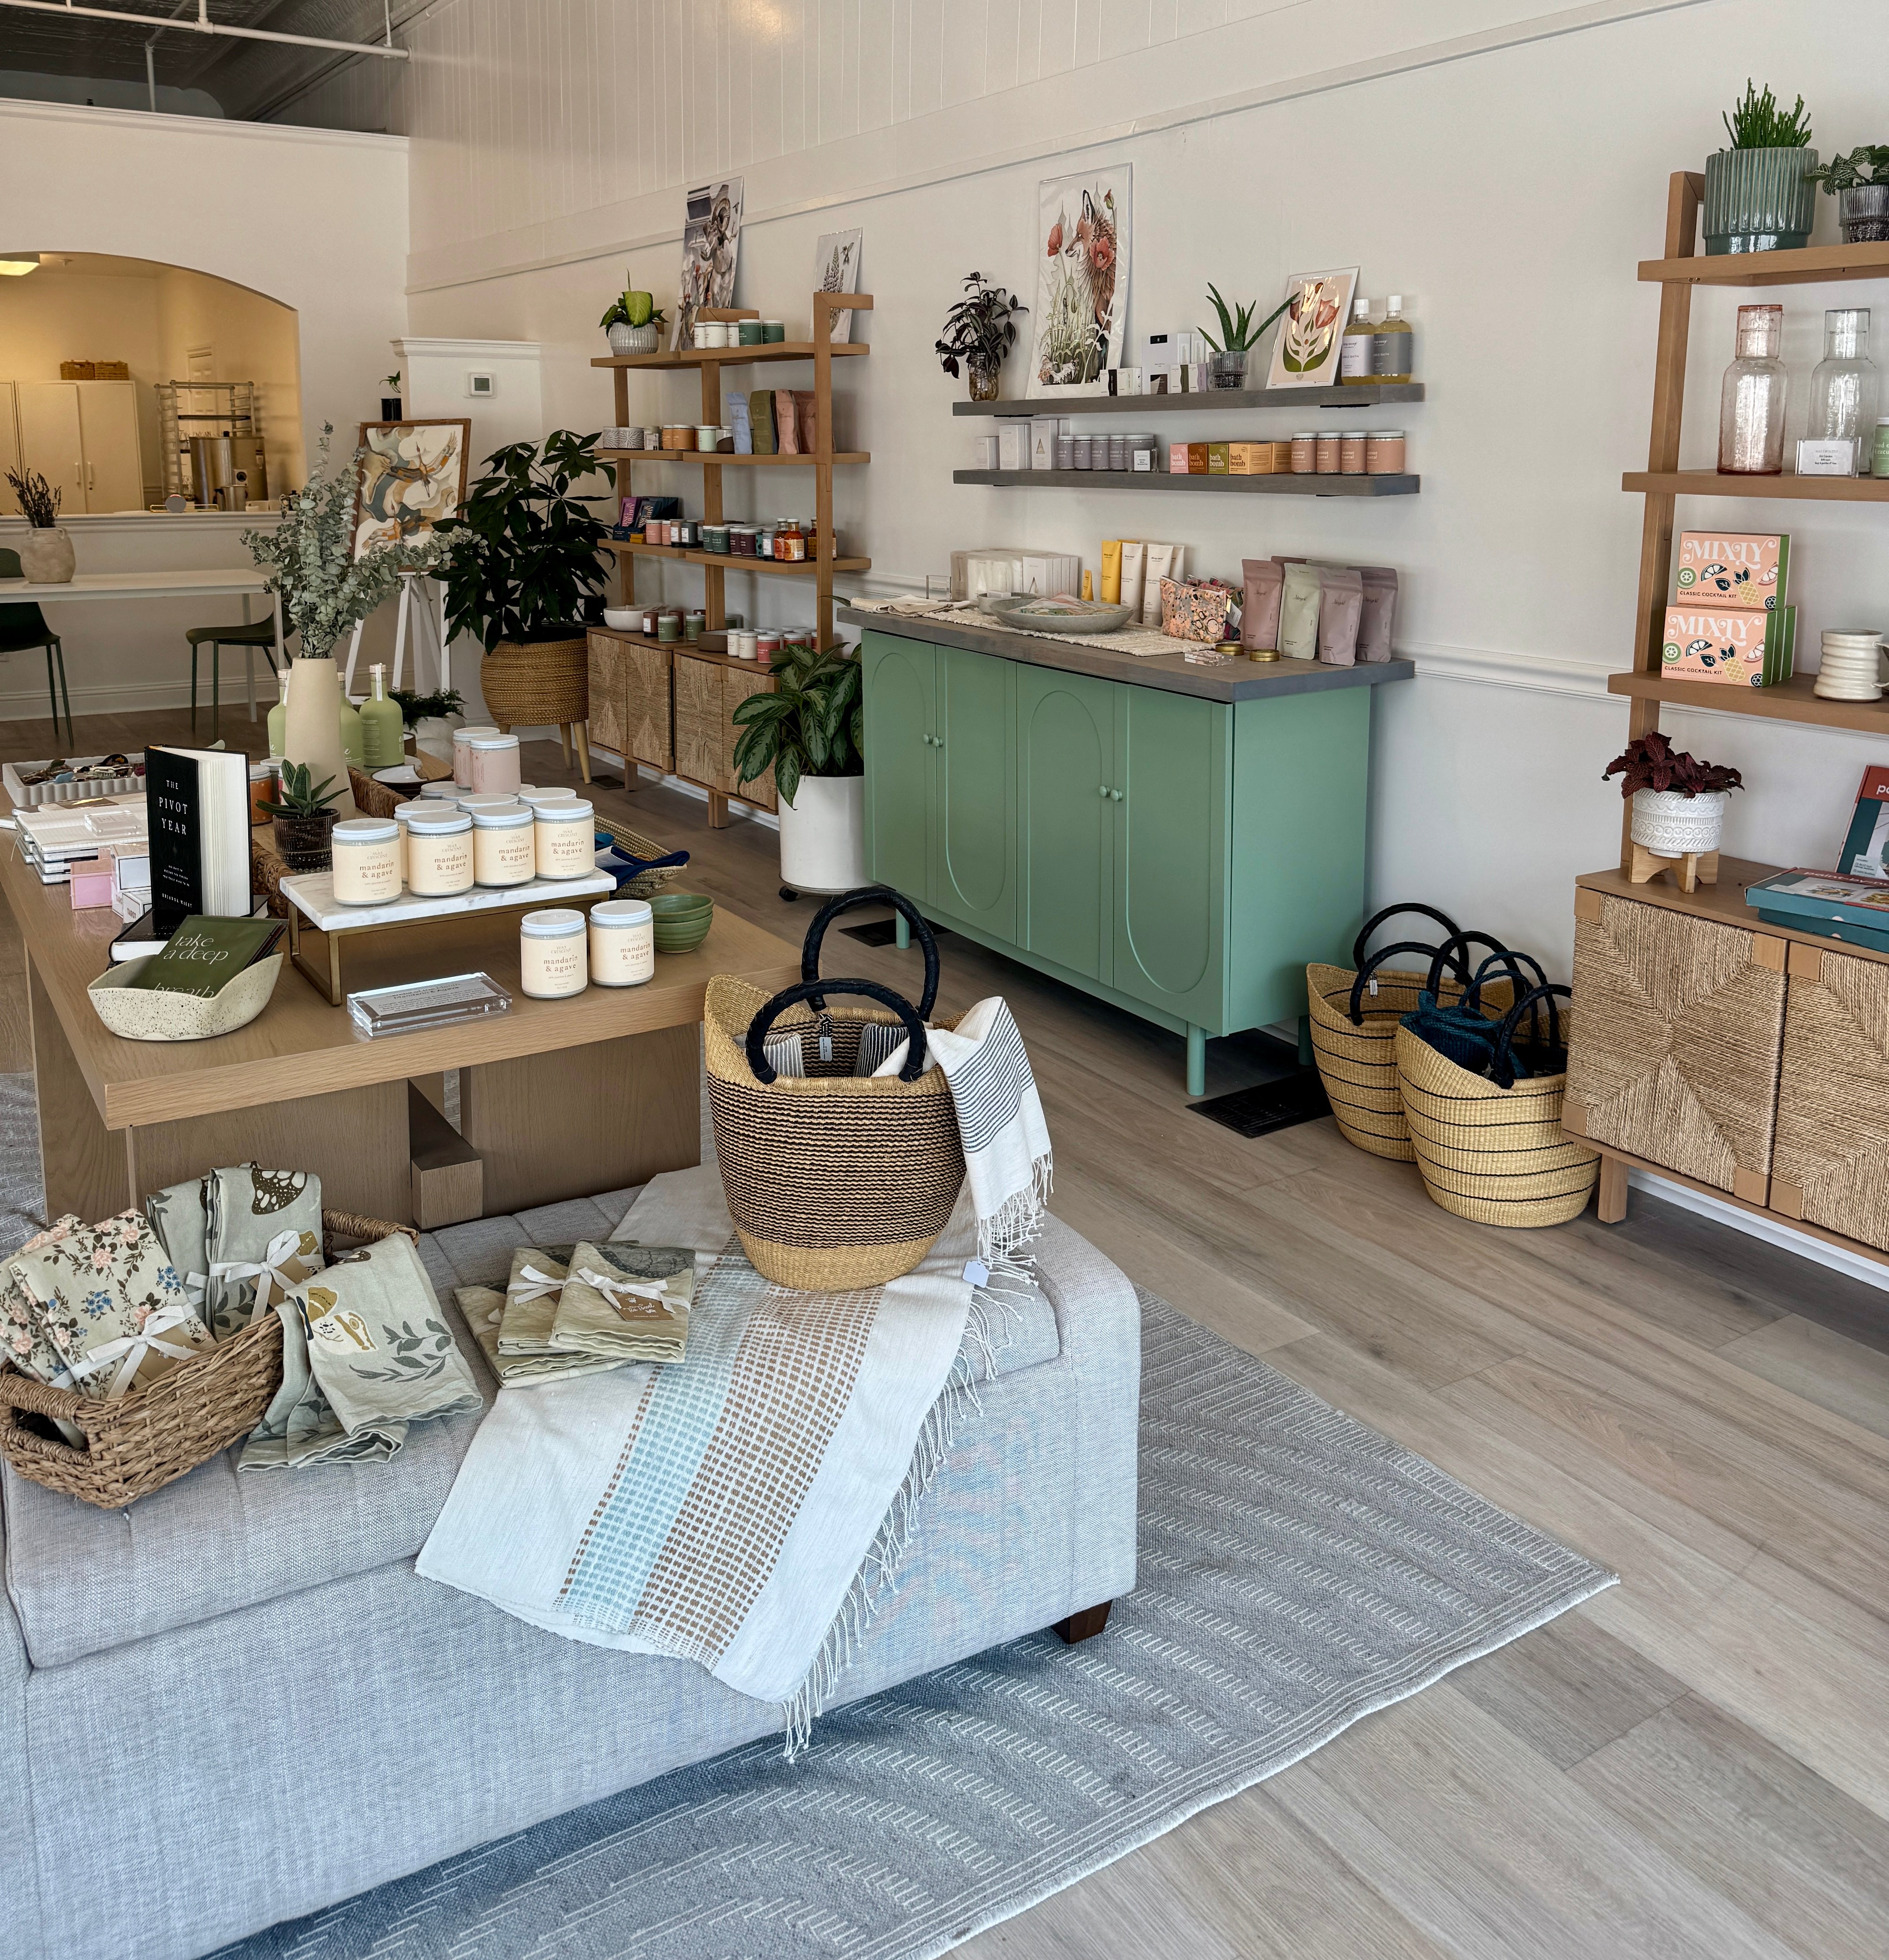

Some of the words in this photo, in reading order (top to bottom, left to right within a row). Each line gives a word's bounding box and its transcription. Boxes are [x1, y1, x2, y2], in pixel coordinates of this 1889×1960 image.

[1682, 538, 1777, 569] MIXLY
[1667, 615, 1763, 646] MIXLY
[166, 780, 179, 789] THE
[159, 797, 187, 814] PIVOT
[161, 818, 186, 835] YEAR
[551, 839, 584, 847] mandarin
[499, 844, 530, 854] mandarin
[435, 852, 467, 863] mandarin
[360, 860, 394, 871] mandarin
[446, 862, 466, 871] agave
[371, 870, 392, 878] agave
[175, 933, 214, 947] take
[620, 942, 650, 953] mandarin
[164, 950, 176, 959] a
[179, 946, 228, 965] deep
[544, 955, 578, 964] mandarin
[631, 951, 649, 960] agave
[555, 964, 576, 973] agave
